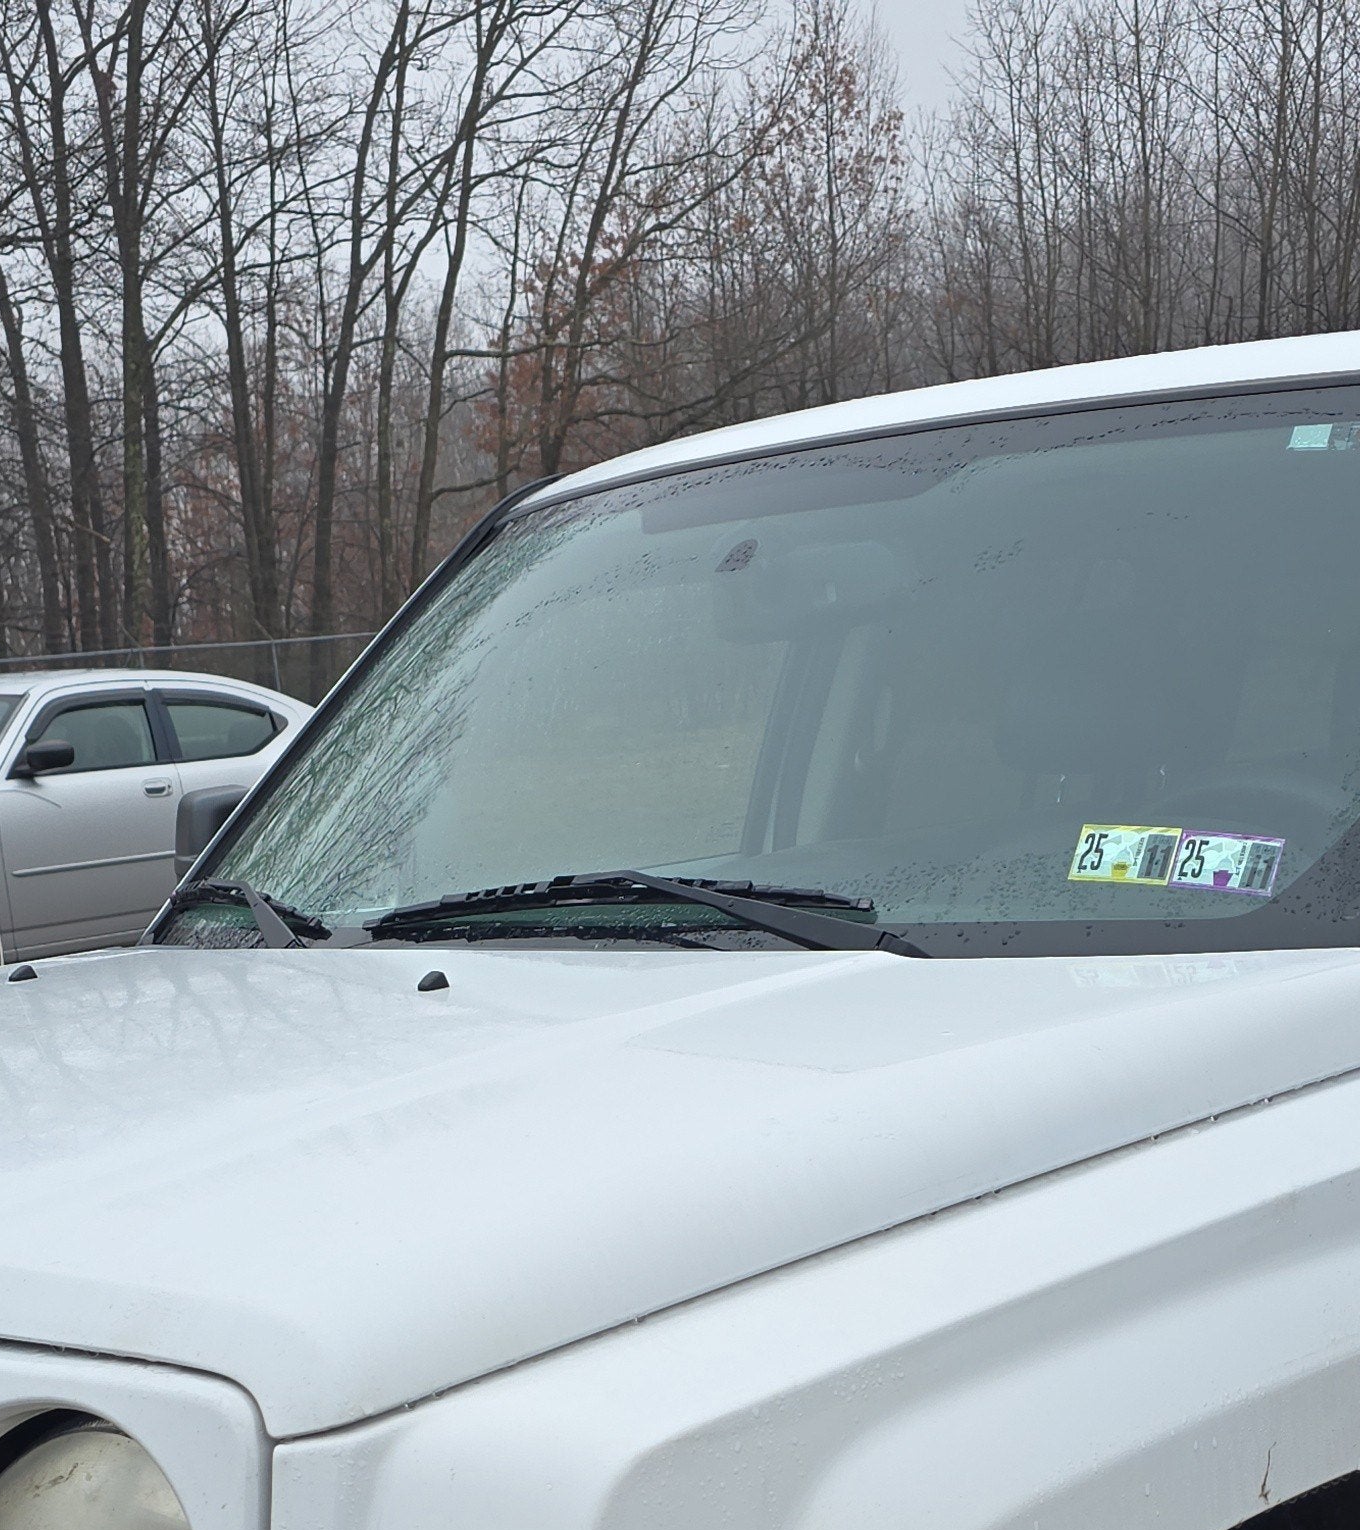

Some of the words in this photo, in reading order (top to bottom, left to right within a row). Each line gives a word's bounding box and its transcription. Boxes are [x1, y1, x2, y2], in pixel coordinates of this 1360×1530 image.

[1078, 832, 1109, 871] 25
[1144, 844, 1172, 878] 11
[1178, 839, 1210, 879] 25
